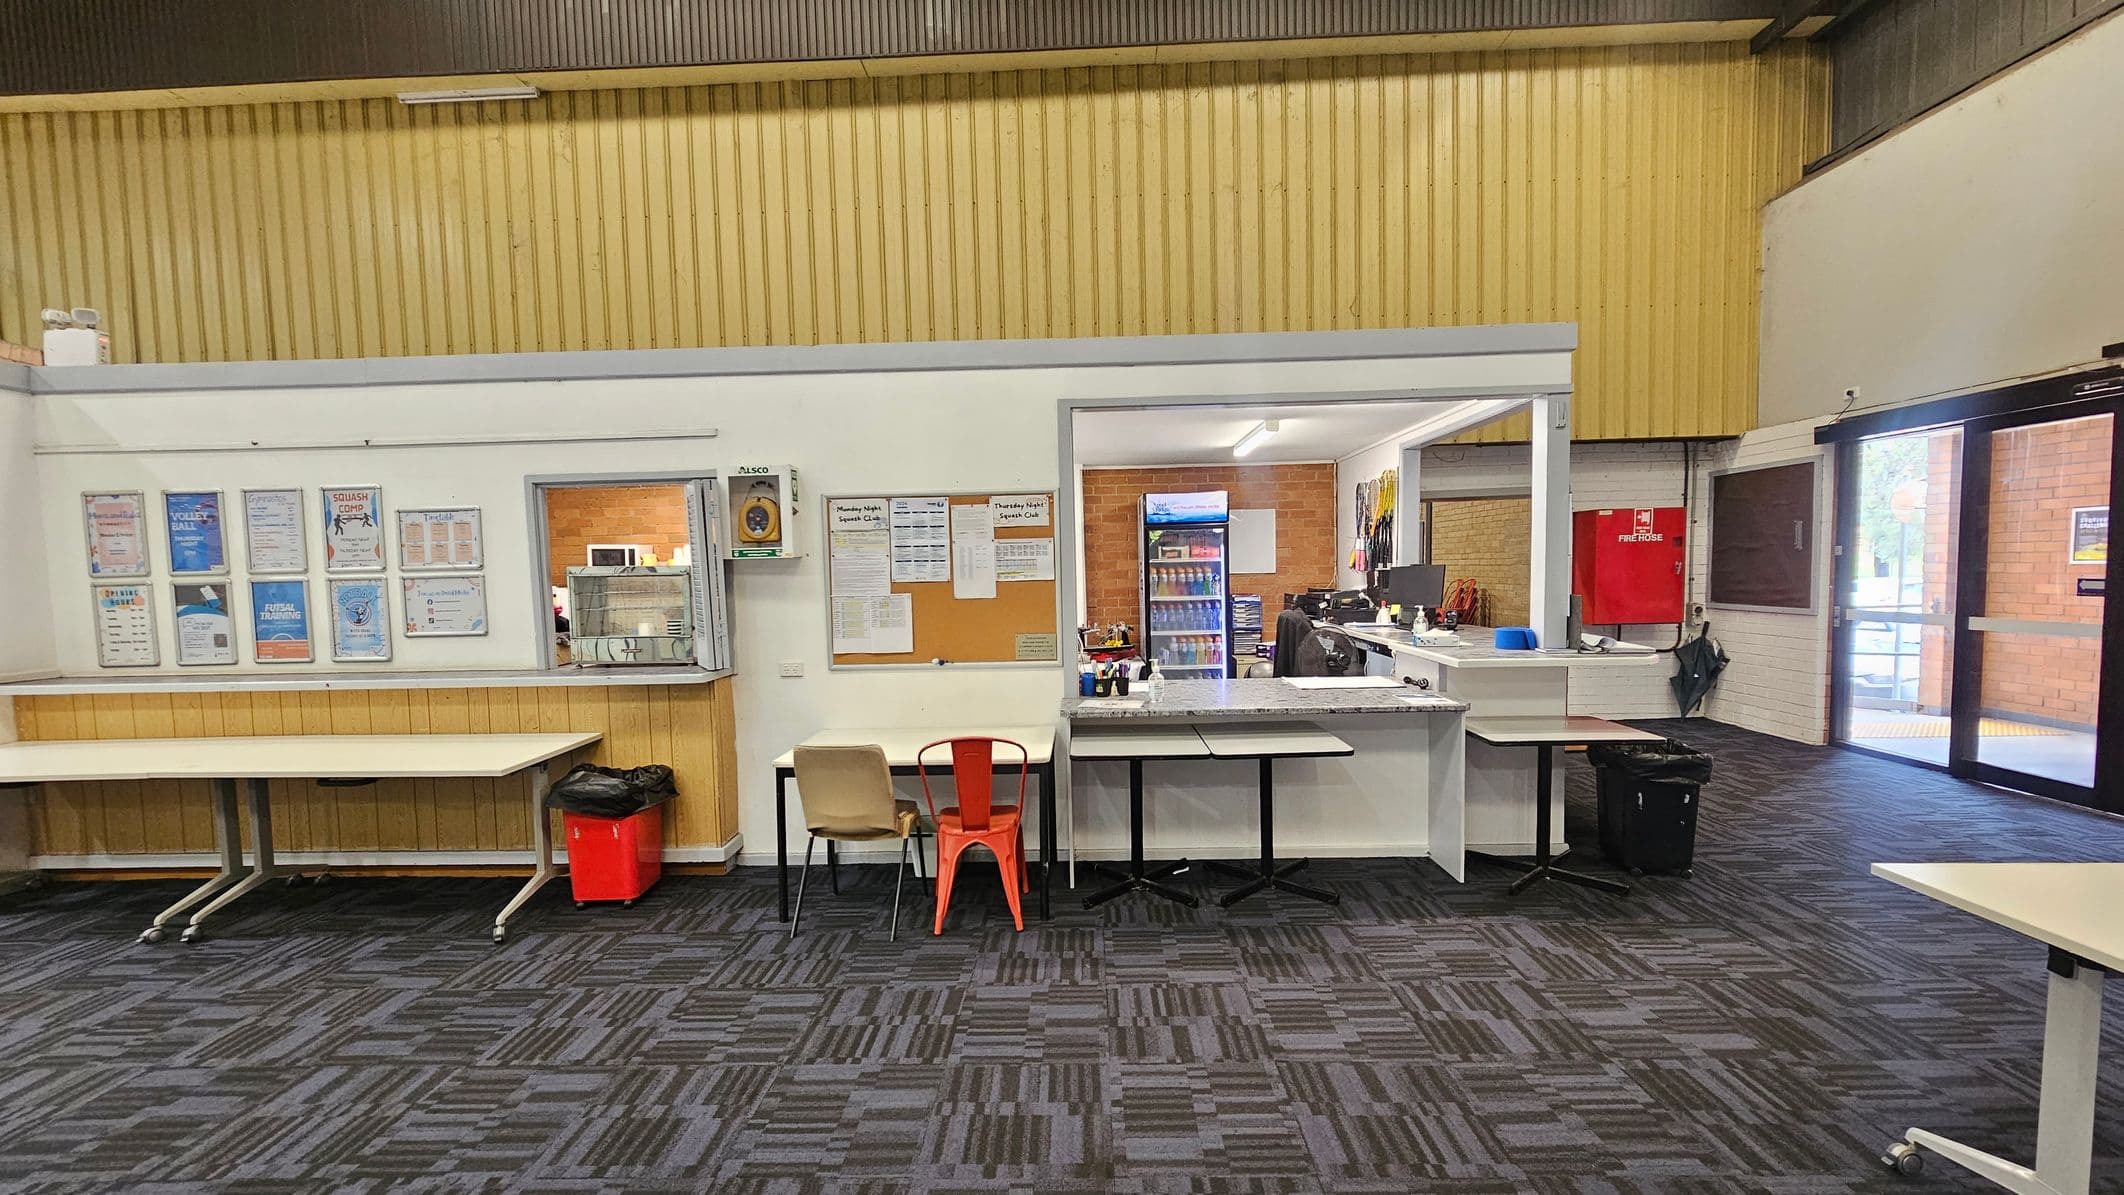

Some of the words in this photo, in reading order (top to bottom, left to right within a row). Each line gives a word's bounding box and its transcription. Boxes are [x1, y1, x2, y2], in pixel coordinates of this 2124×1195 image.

[738, 466, 769, 474] ALSCO
[333, 493, 369, 502] SQUASH
[339, 504, 364, 513] COMP
[995, 502, 1025, 510] Thursday
[1026, 502, 1044, 510] Night
[170, 512, 209, 521] VOLLEY
[839, 515, 862, 523] Squash
[1000, 512, 1023, 520] Squash
[1024, 511, 1040, 519] Club
[172, 522, 197, 530] BALL
[1618, 534, 1637, 542] FIRE
[1638, 533, 1664, 542] HOSE
[265, 604, 295, 612] FUTSAL
[260, 611, 302, 620] TRAINING
